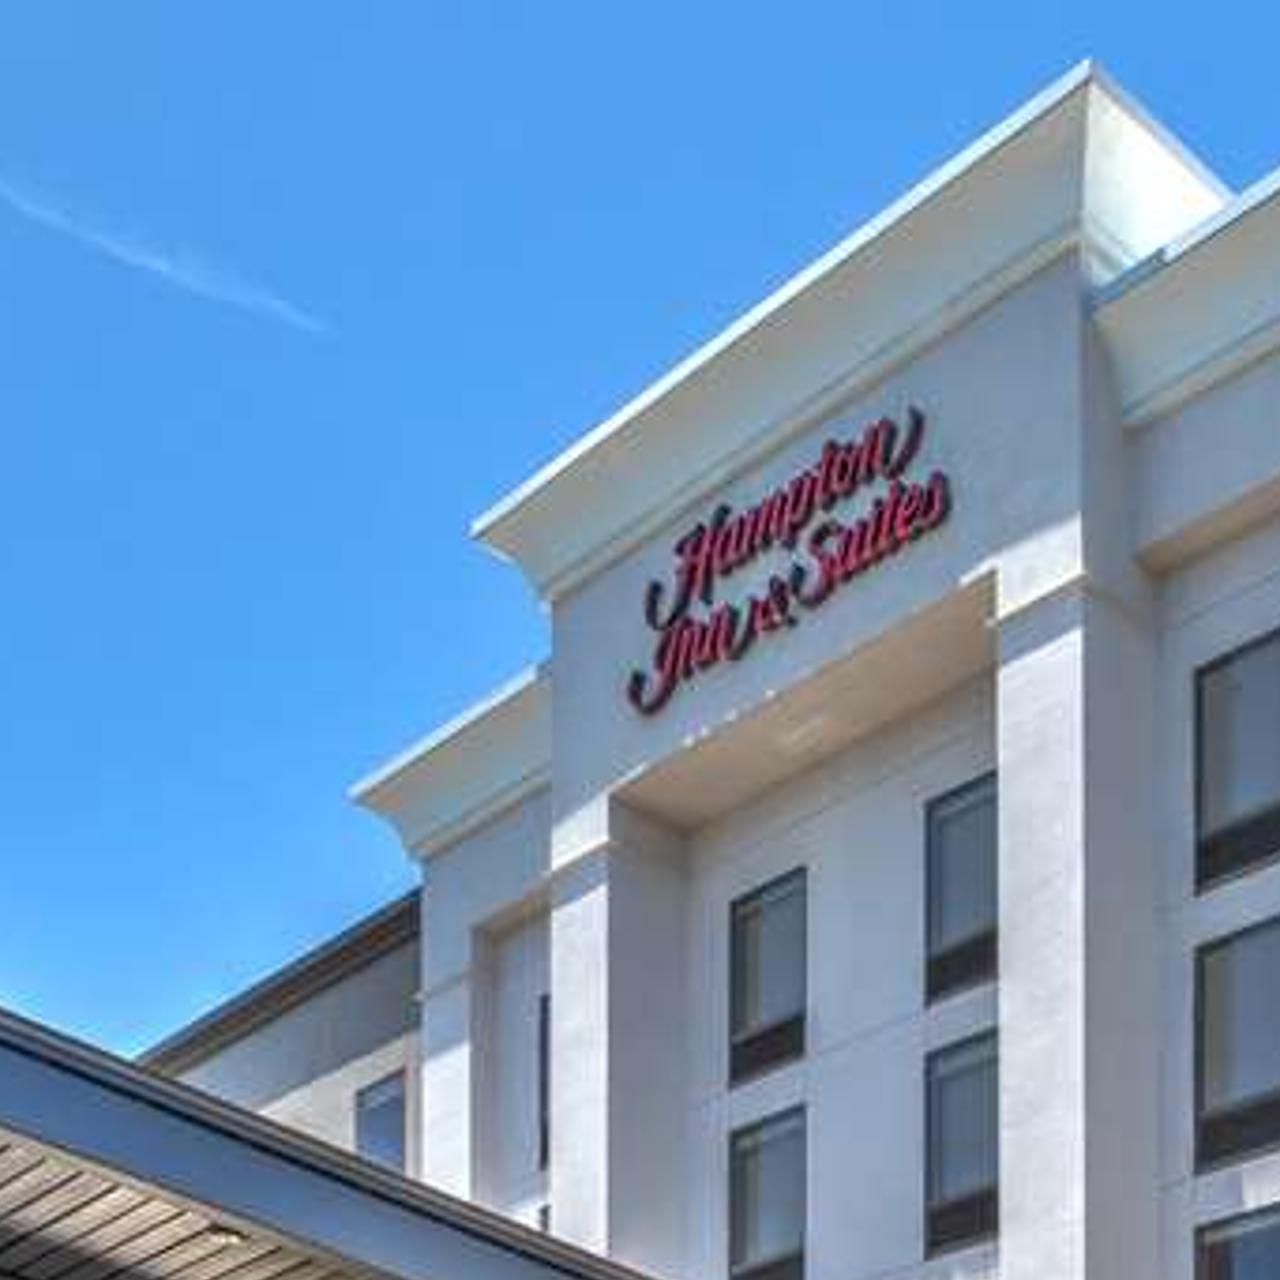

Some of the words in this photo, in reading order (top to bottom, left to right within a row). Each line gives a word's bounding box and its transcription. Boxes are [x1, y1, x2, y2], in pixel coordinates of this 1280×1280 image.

[628, 597, 757, 716] Inn
[791, 469, 952, 608] Suites
[646, 405, 926, 631] Hampton
